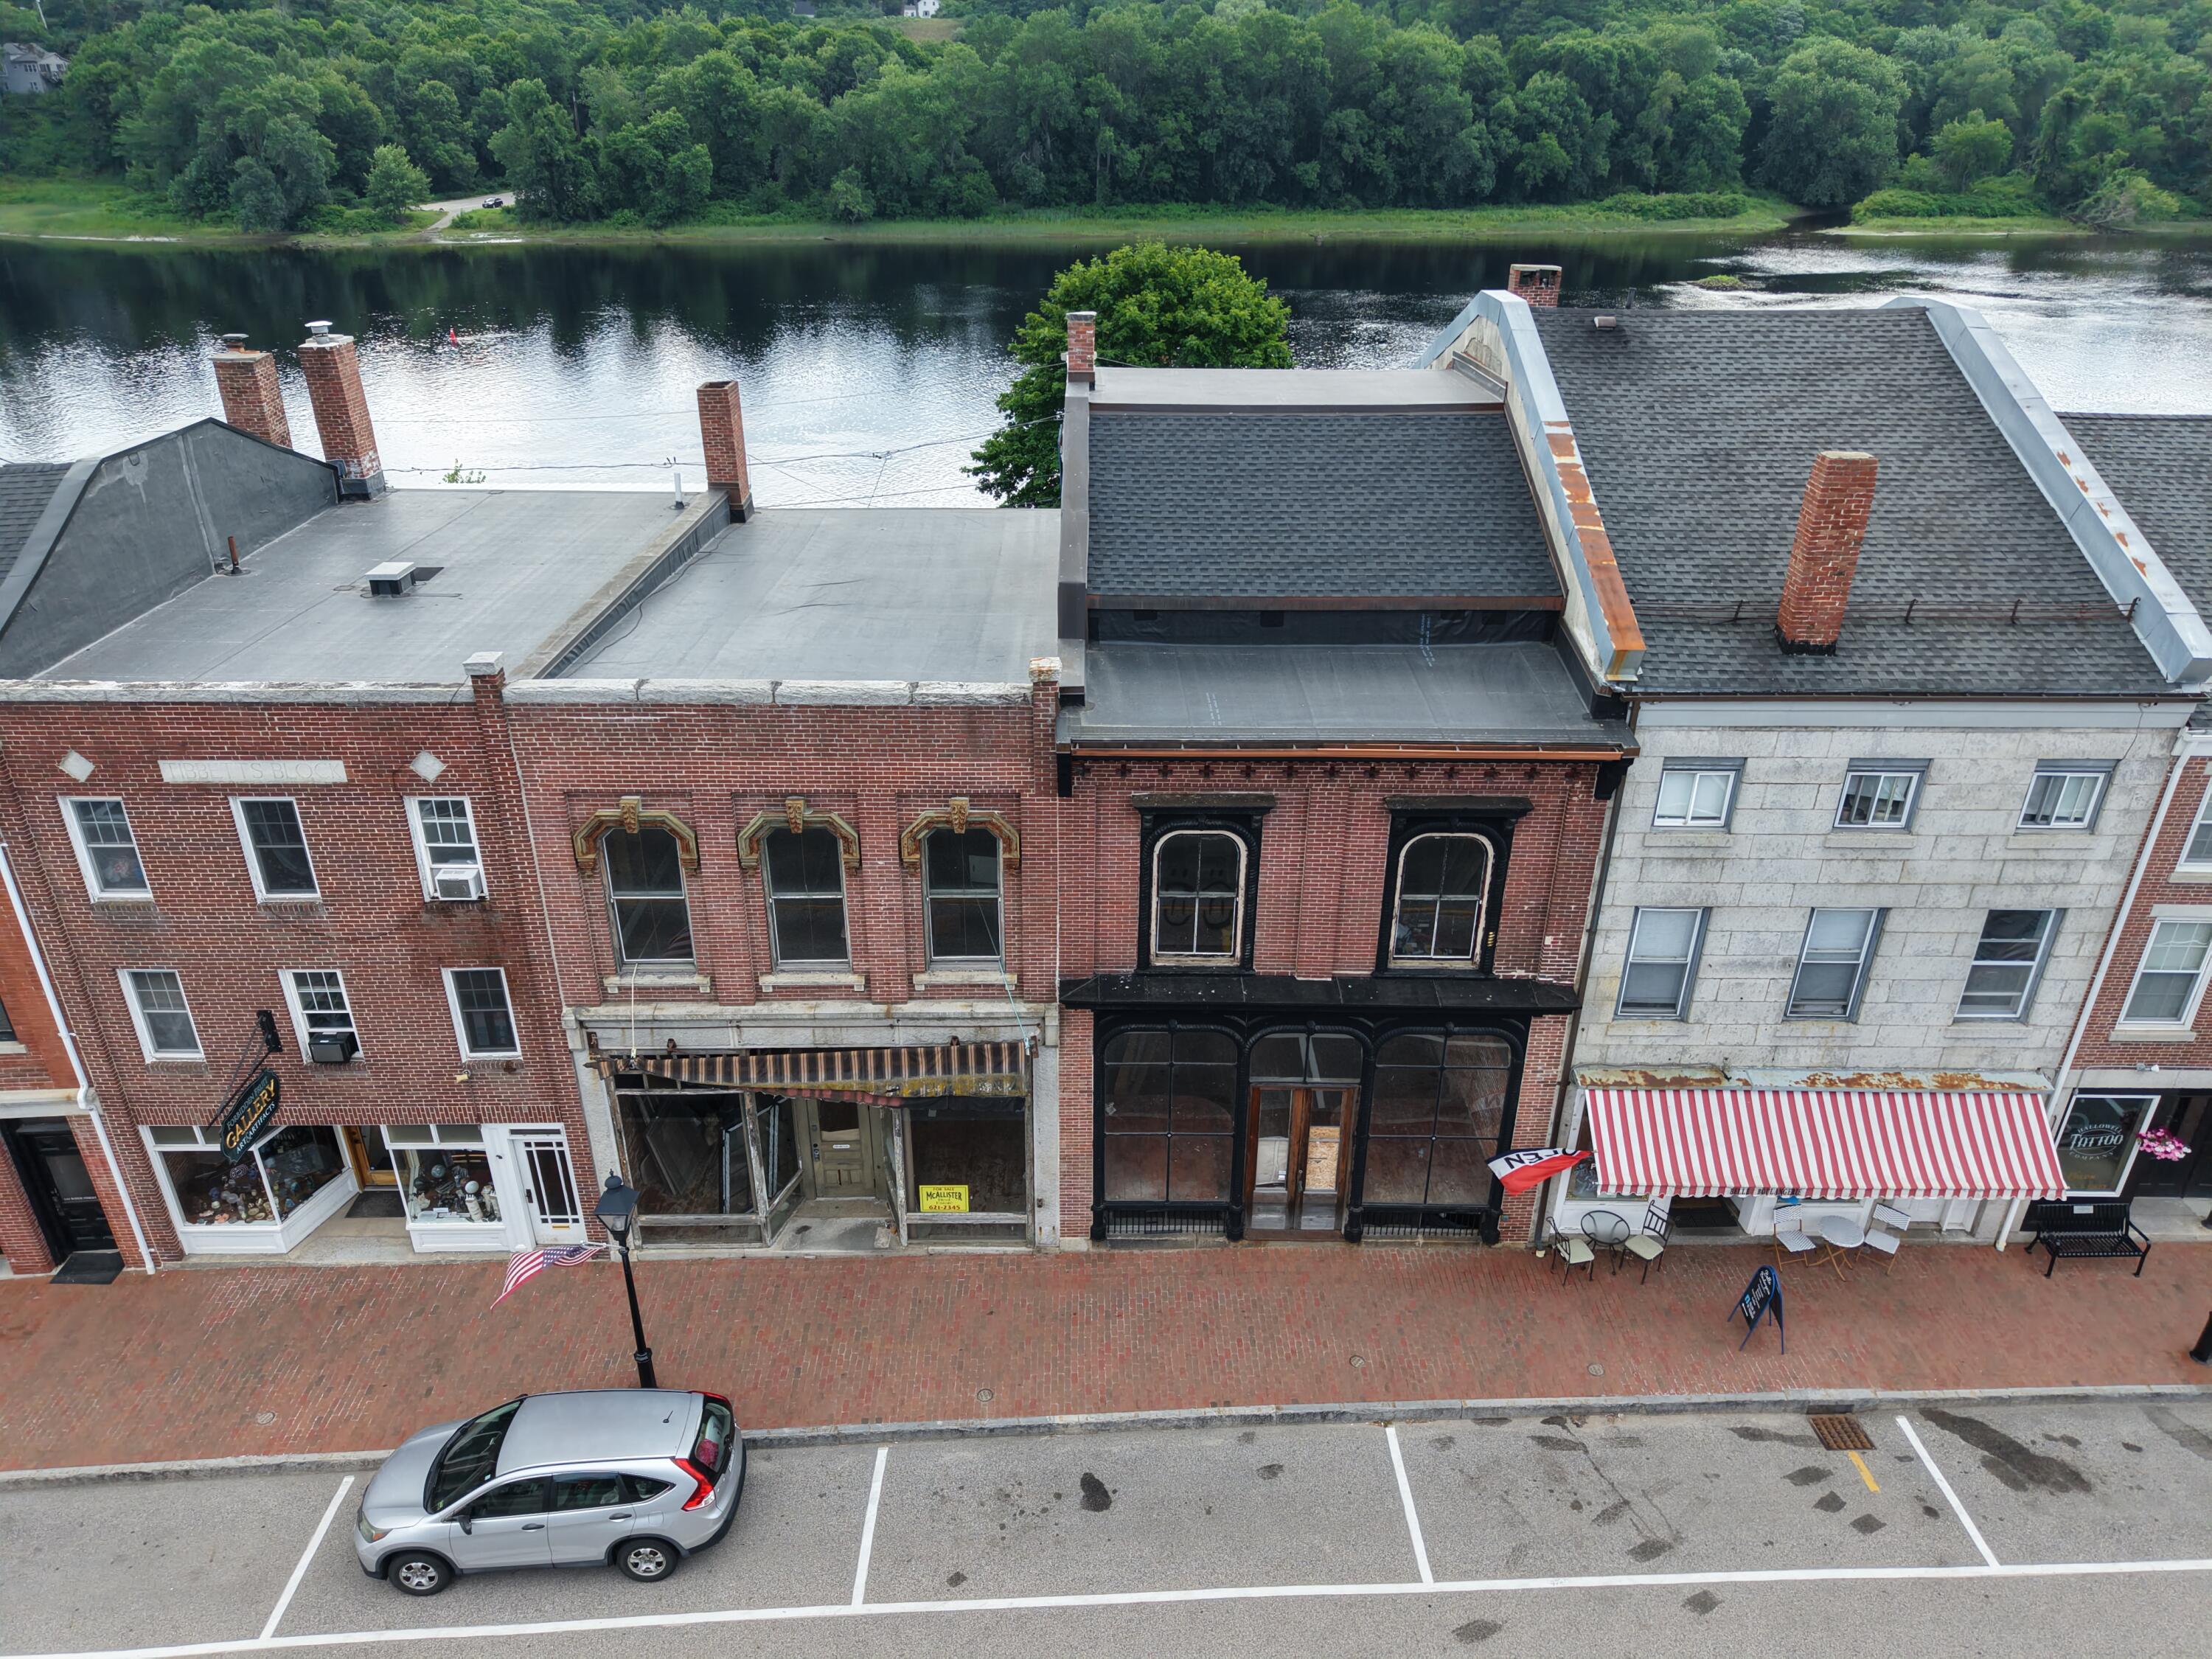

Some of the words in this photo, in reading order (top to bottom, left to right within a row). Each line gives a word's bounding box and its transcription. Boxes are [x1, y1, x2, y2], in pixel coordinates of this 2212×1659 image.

[163, 762, 263, 780] TIBBETTS
[271, 762, 344, 779] BLOCK
[226, 1079, 276, 1149] GALLERY
[227, 1093, 254, 1130] FORBIDDEN
[254, 1077, 268, 1096] FRUIT
[236, 1138, 248, 1154] ART
[248, 1102, 276, 1138] ARTIFACTS
[2070, 1133, 2124, 1150] TATTOO
[2077, 1124, 2123, 1134] HALLOWELL
